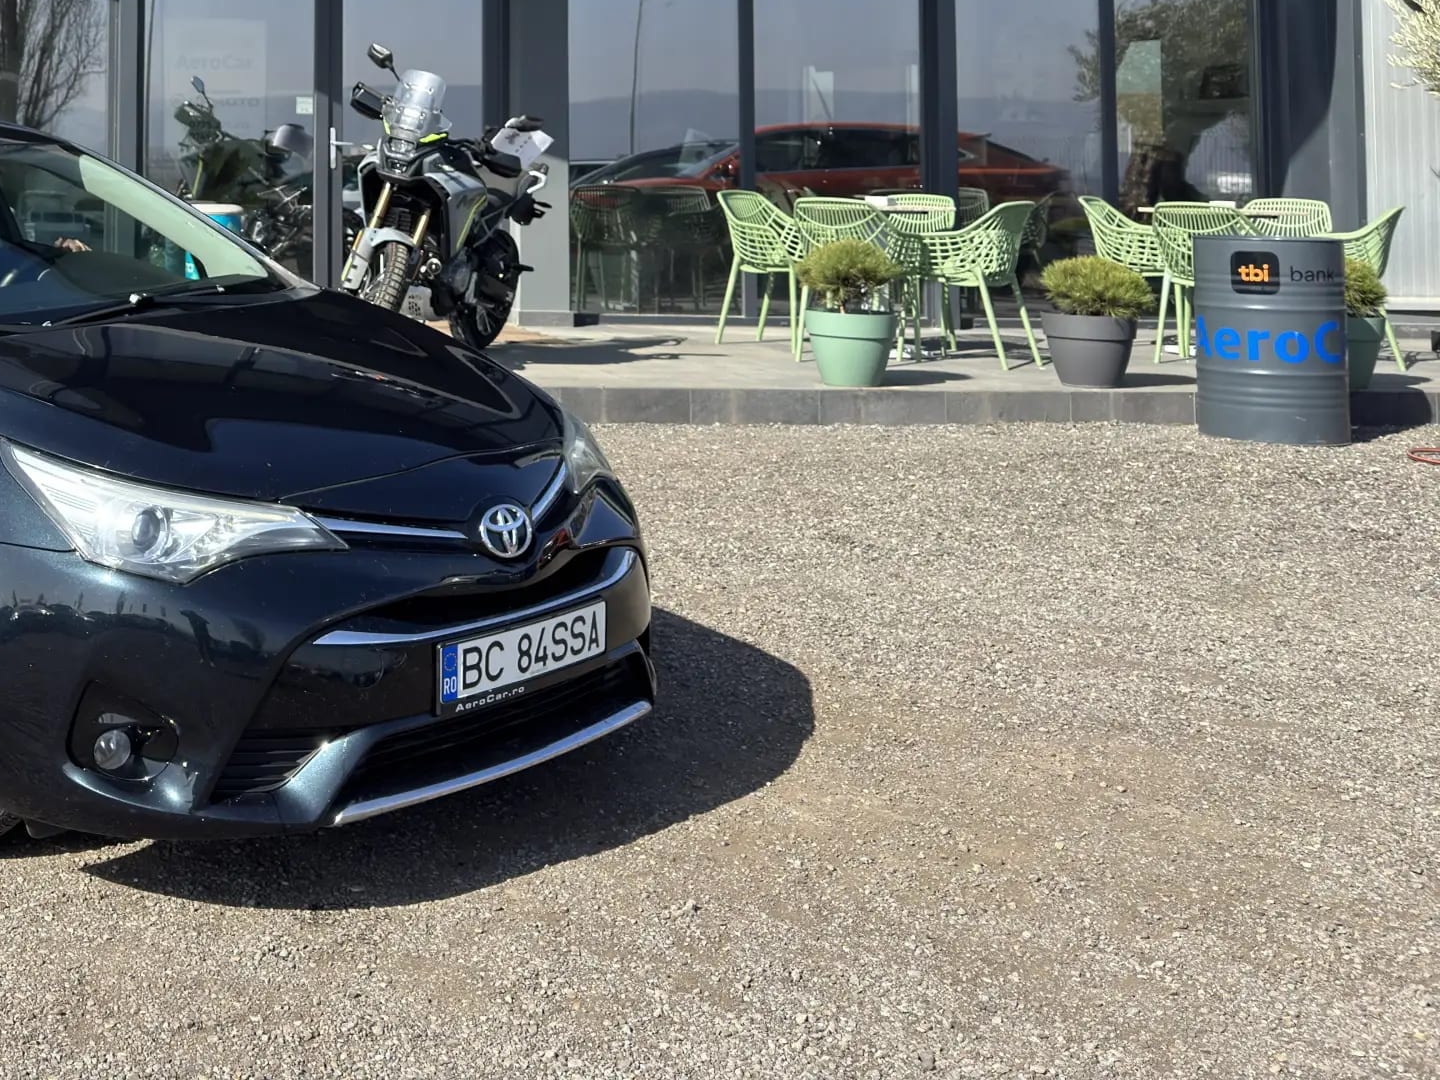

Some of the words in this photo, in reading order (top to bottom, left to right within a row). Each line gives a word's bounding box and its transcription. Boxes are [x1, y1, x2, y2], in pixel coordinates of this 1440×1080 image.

[1238, 264, 1269, 283] tbi
[1290, 266, 1335, 283] bank
[462, 640, 505, 691] BC
[517, 611, 600, 674] 84SSA
[443, 676, 457, 695] RO
[455, 686, 525, 713] AeroCar.ro
